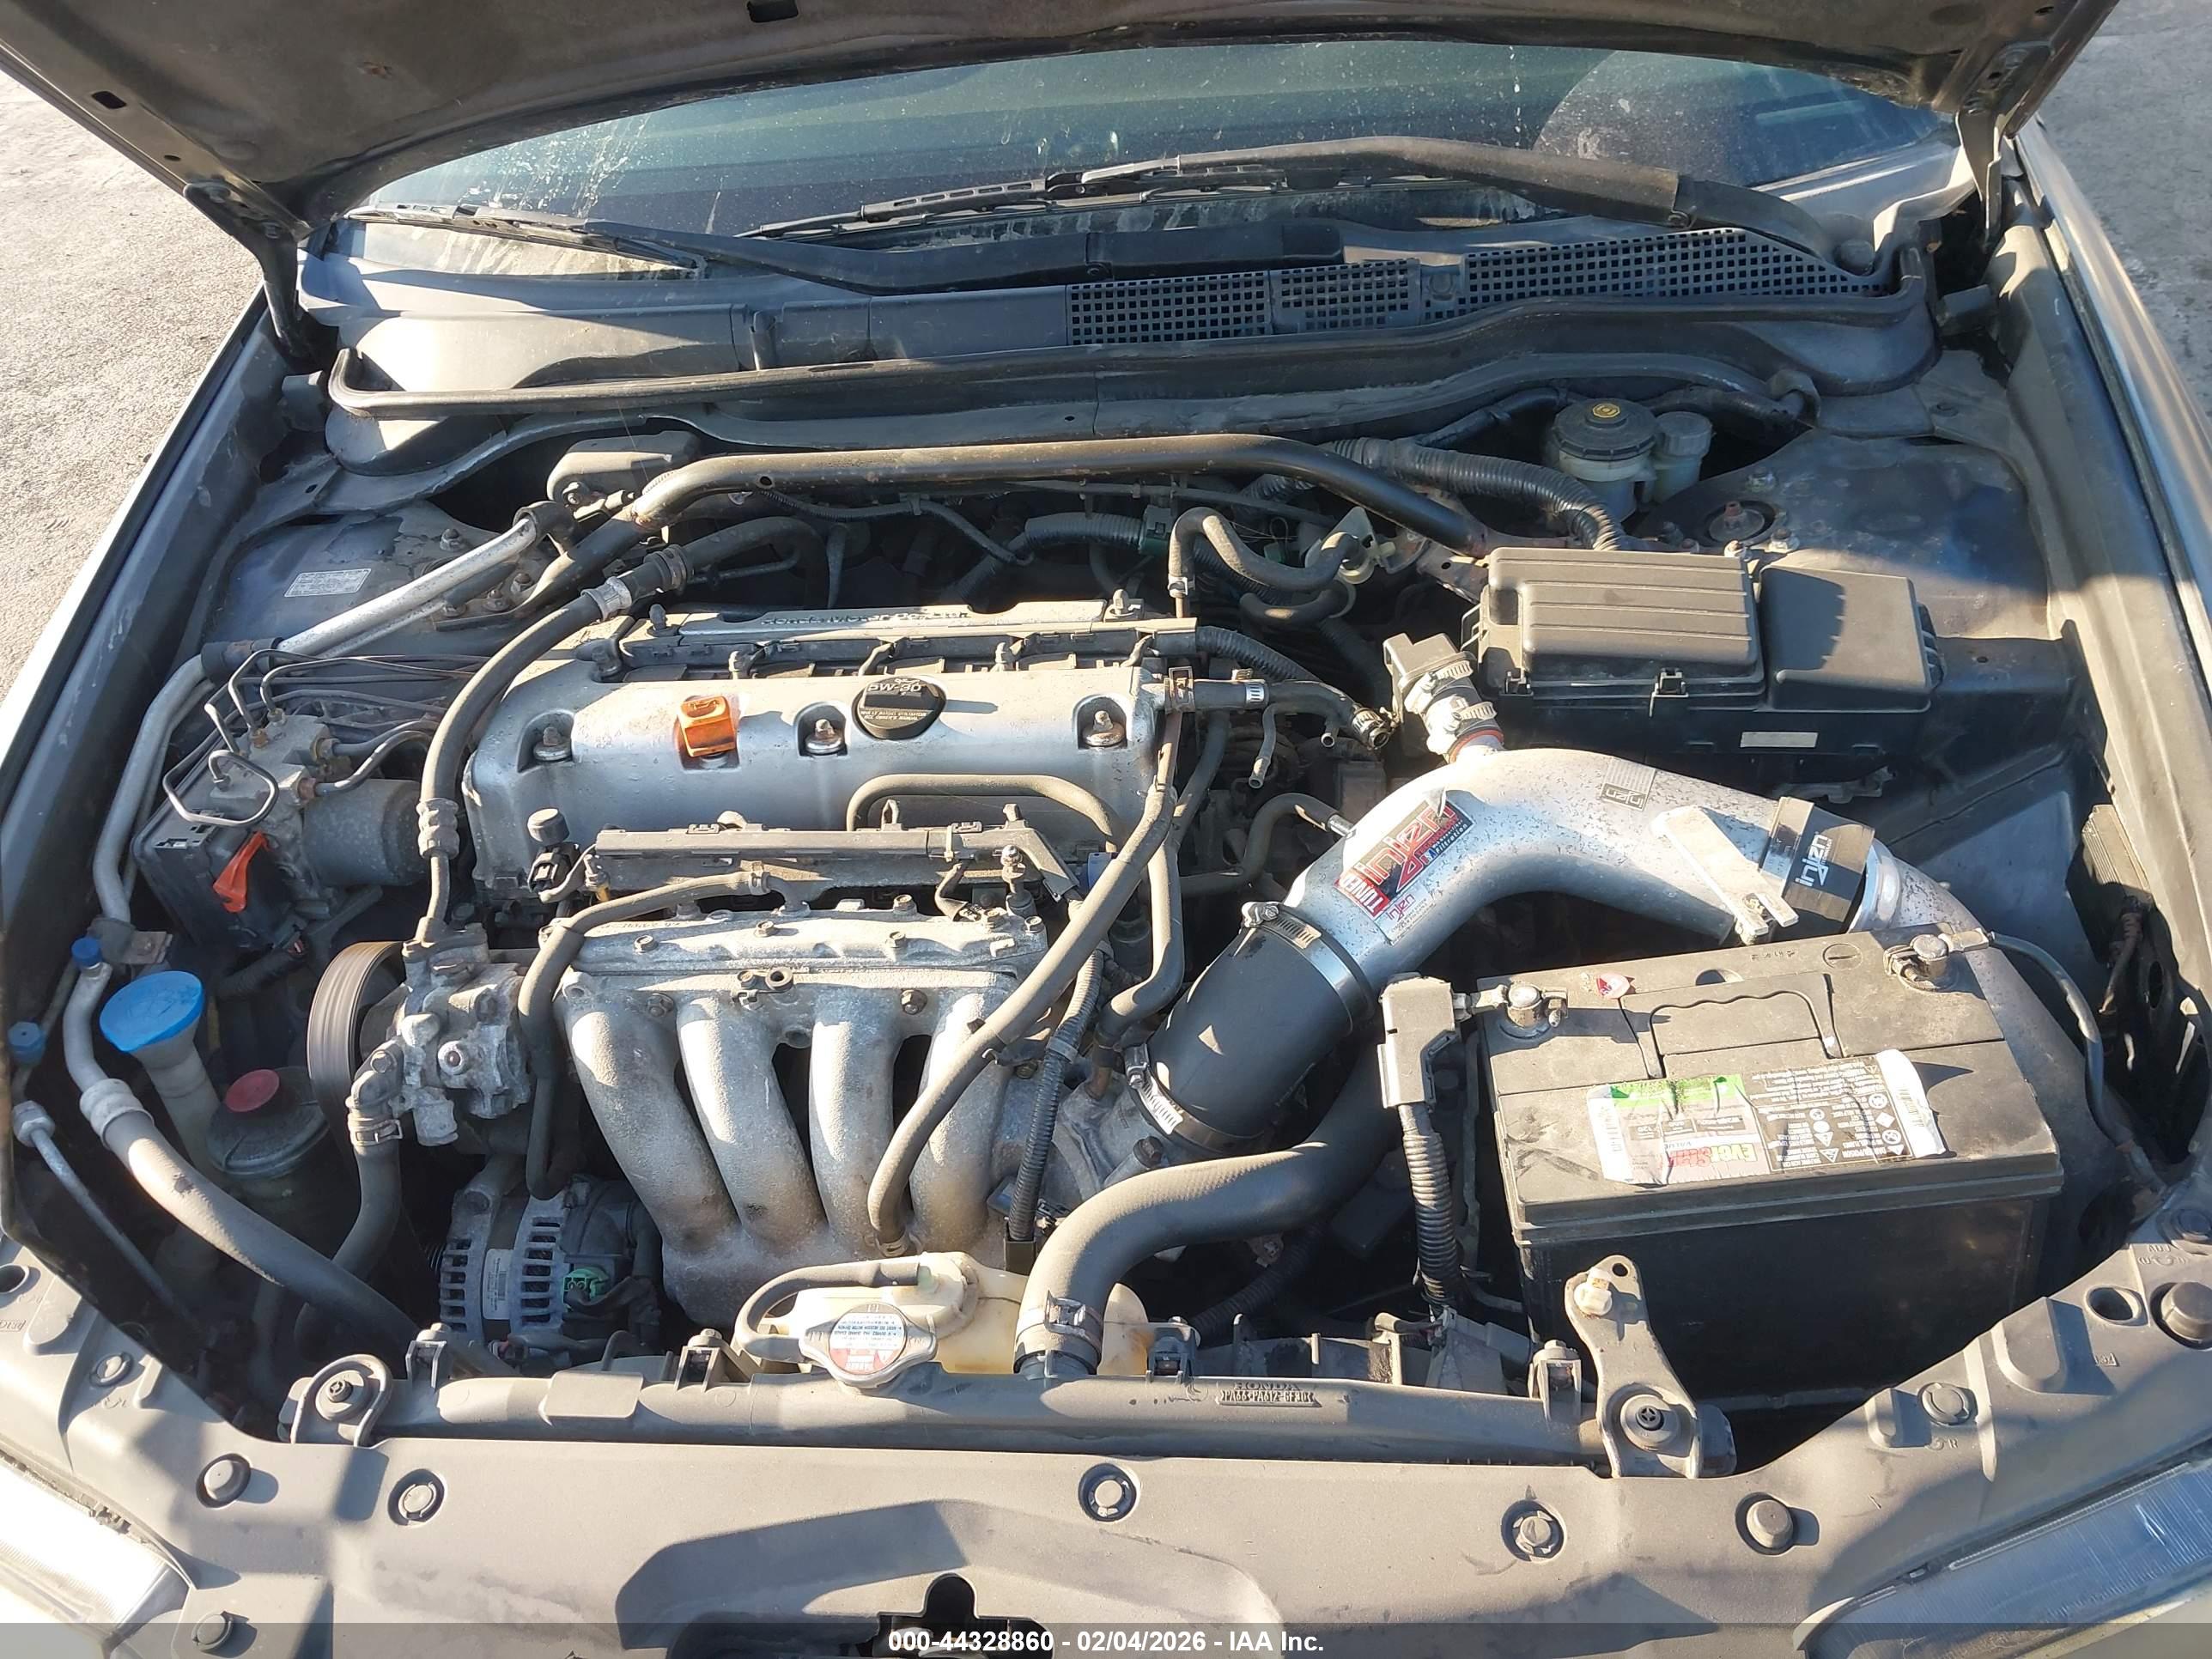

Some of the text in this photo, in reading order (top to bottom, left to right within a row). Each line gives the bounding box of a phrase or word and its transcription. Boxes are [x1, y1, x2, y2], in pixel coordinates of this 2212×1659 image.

[868, 683, 921, 694] 5W-30
[1354, 800, 1455, 893] injen
[1435, 822, 1468, 854] Filtration
[1796, 835, 1829, 886] injen
[1663, 1143, 1758, 1168] EverStar
[1664, 1140, 1692, 1149] VALUE
[1233, 1381, 1300, 1390] HONDA
